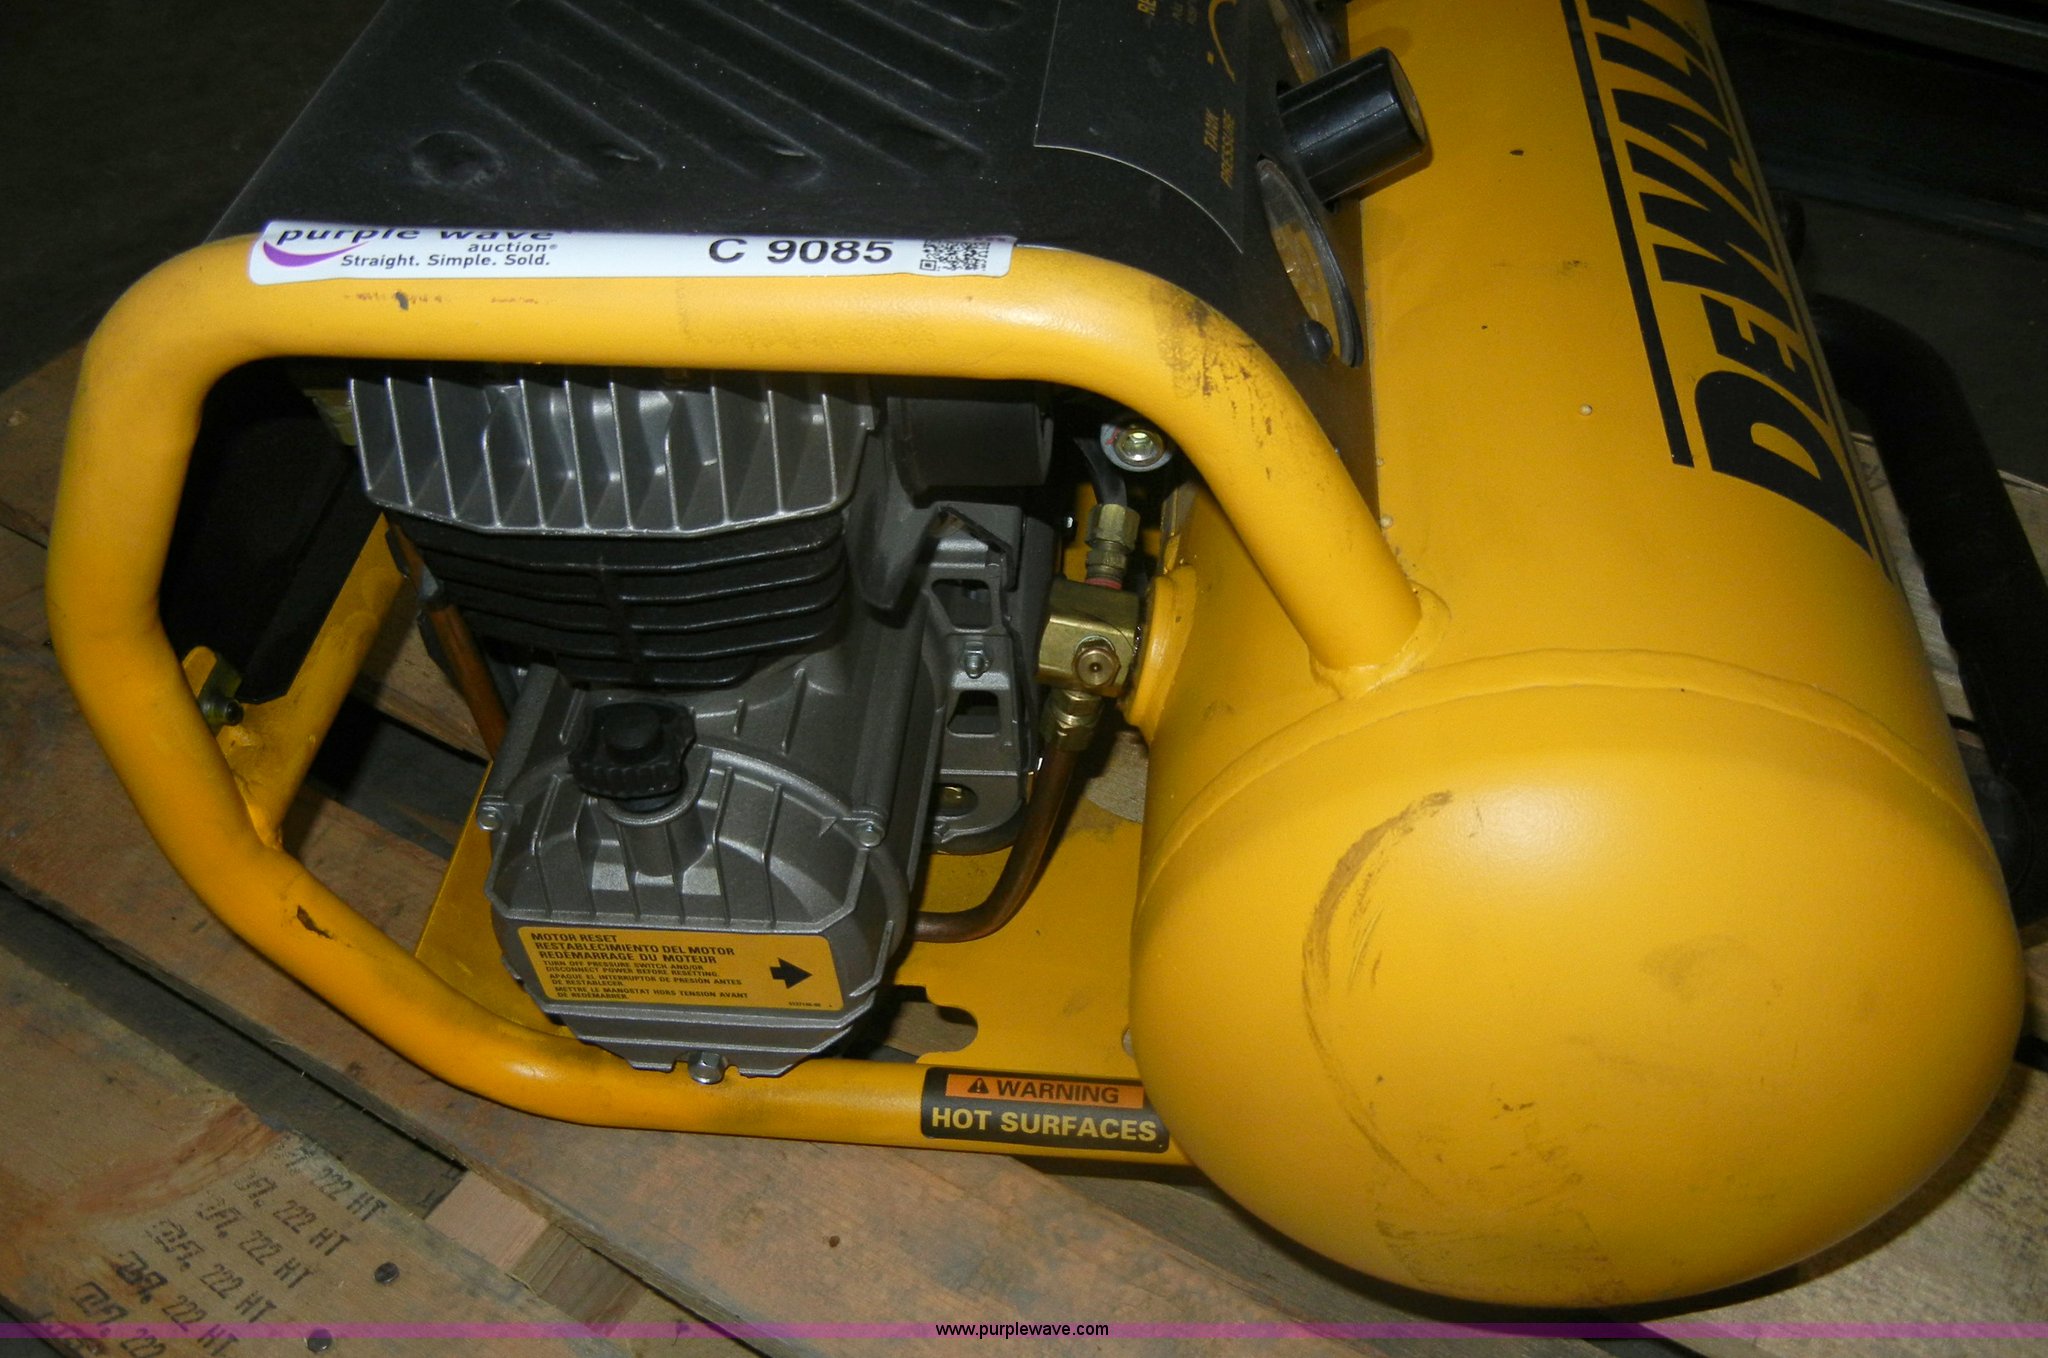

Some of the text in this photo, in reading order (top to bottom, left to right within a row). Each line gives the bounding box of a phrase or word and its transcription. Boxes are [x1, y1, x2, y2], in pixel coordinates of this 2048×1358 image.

[341, 253, 551, 269] Straight. Simple. Sold.
[708, 238, 895, 264] C 9085
[531, 932, 618, 943] MOTOR RESET
[535, 942, 735, 955] RESTABLECIMIENTO DEL MOTOR
[633, 962, 668, 970] SWITCH
[671, 963, 704, 971] AND/OR
[640, 953, 657, 961] DU
[663, 954, 717, 964] MOTEUR
[680, 990, 717, 998] TENSION
[996, 1079, 1119, 1104] WARNING
[931, 1107, 1157, 1142] HOT SURFACES
[346, 1192, 388, 1222] HT
[273, 1200, 318, 1234] 222
[309, 1227, 350, 1256] HT
[239, 1229, 283, 1266] 222
[273, 1256, 315, 1288] HT
[200, 1263, 245, 1300] 222
[234, 1290, 278, 1324] HT
[162, 1295, 208, 1332] 222
[197, 1324, 240, 1356] HT
